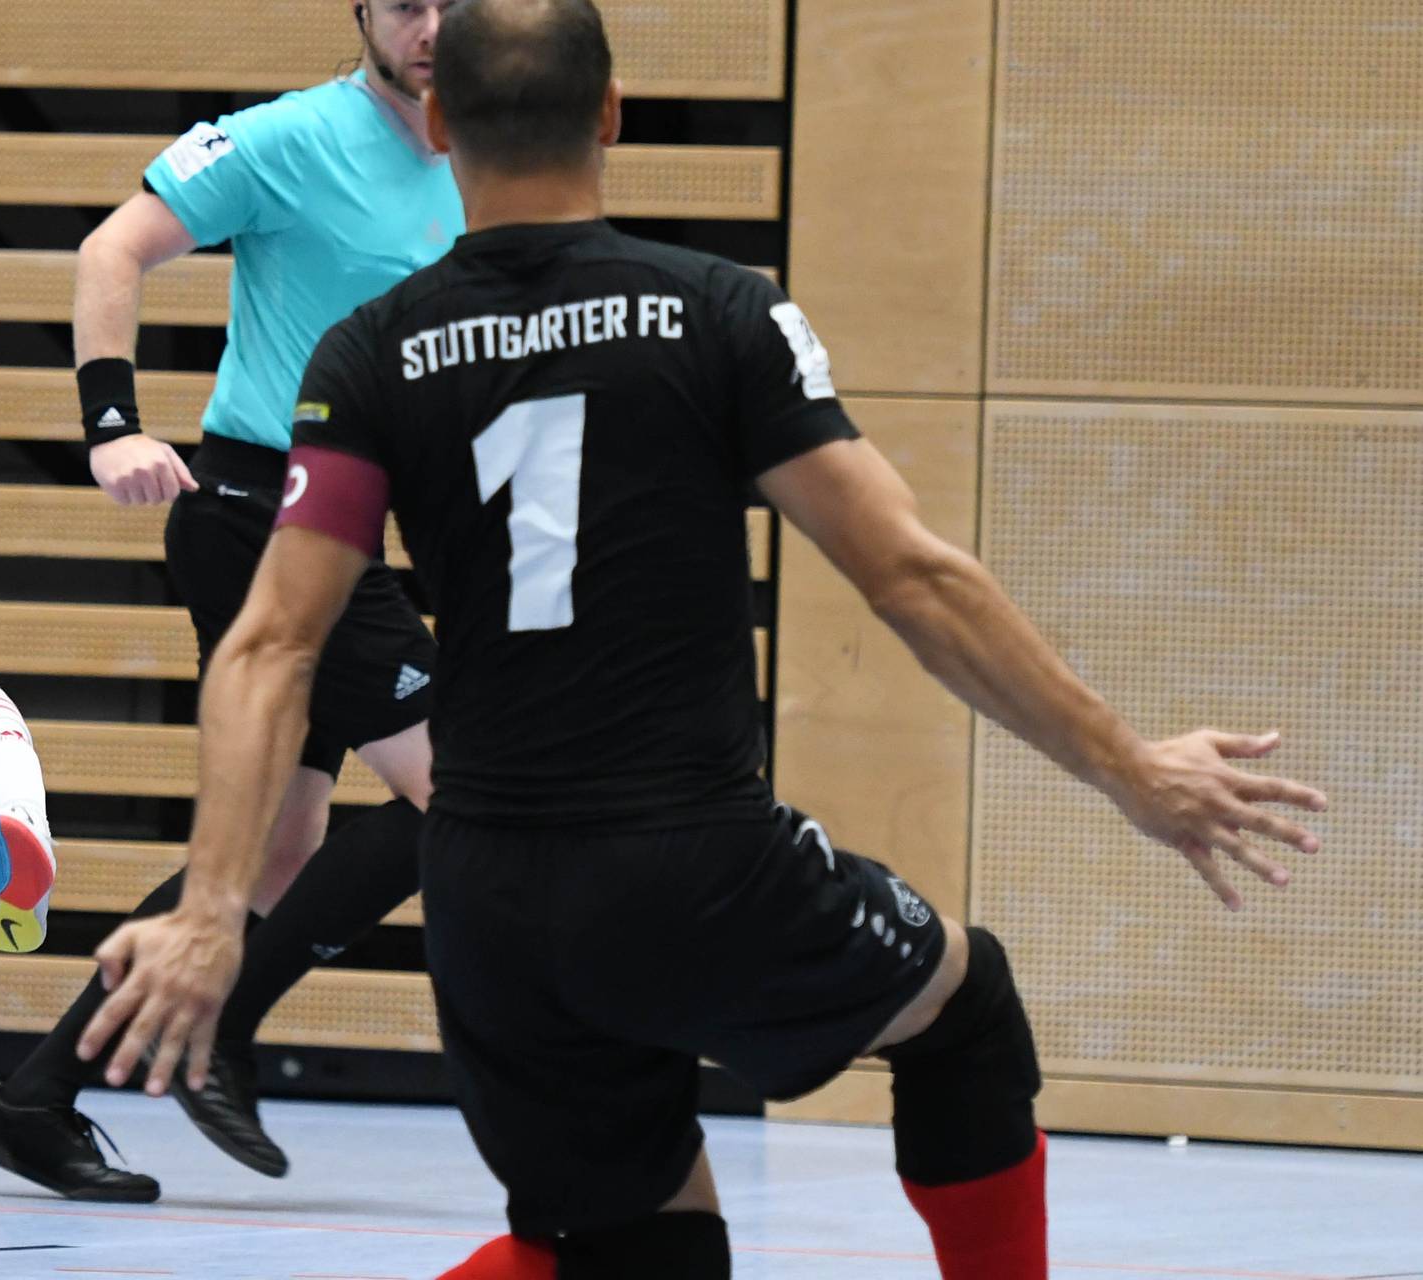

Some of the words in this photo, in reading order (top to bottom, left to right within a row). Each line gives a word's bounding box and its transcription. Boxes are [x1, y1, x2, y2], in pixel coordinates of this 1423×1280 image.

[400, 296, 628, 381] STUTTGARTER
[637, 294, 684, 339] FC
[471, 393, 586, 632] 1
